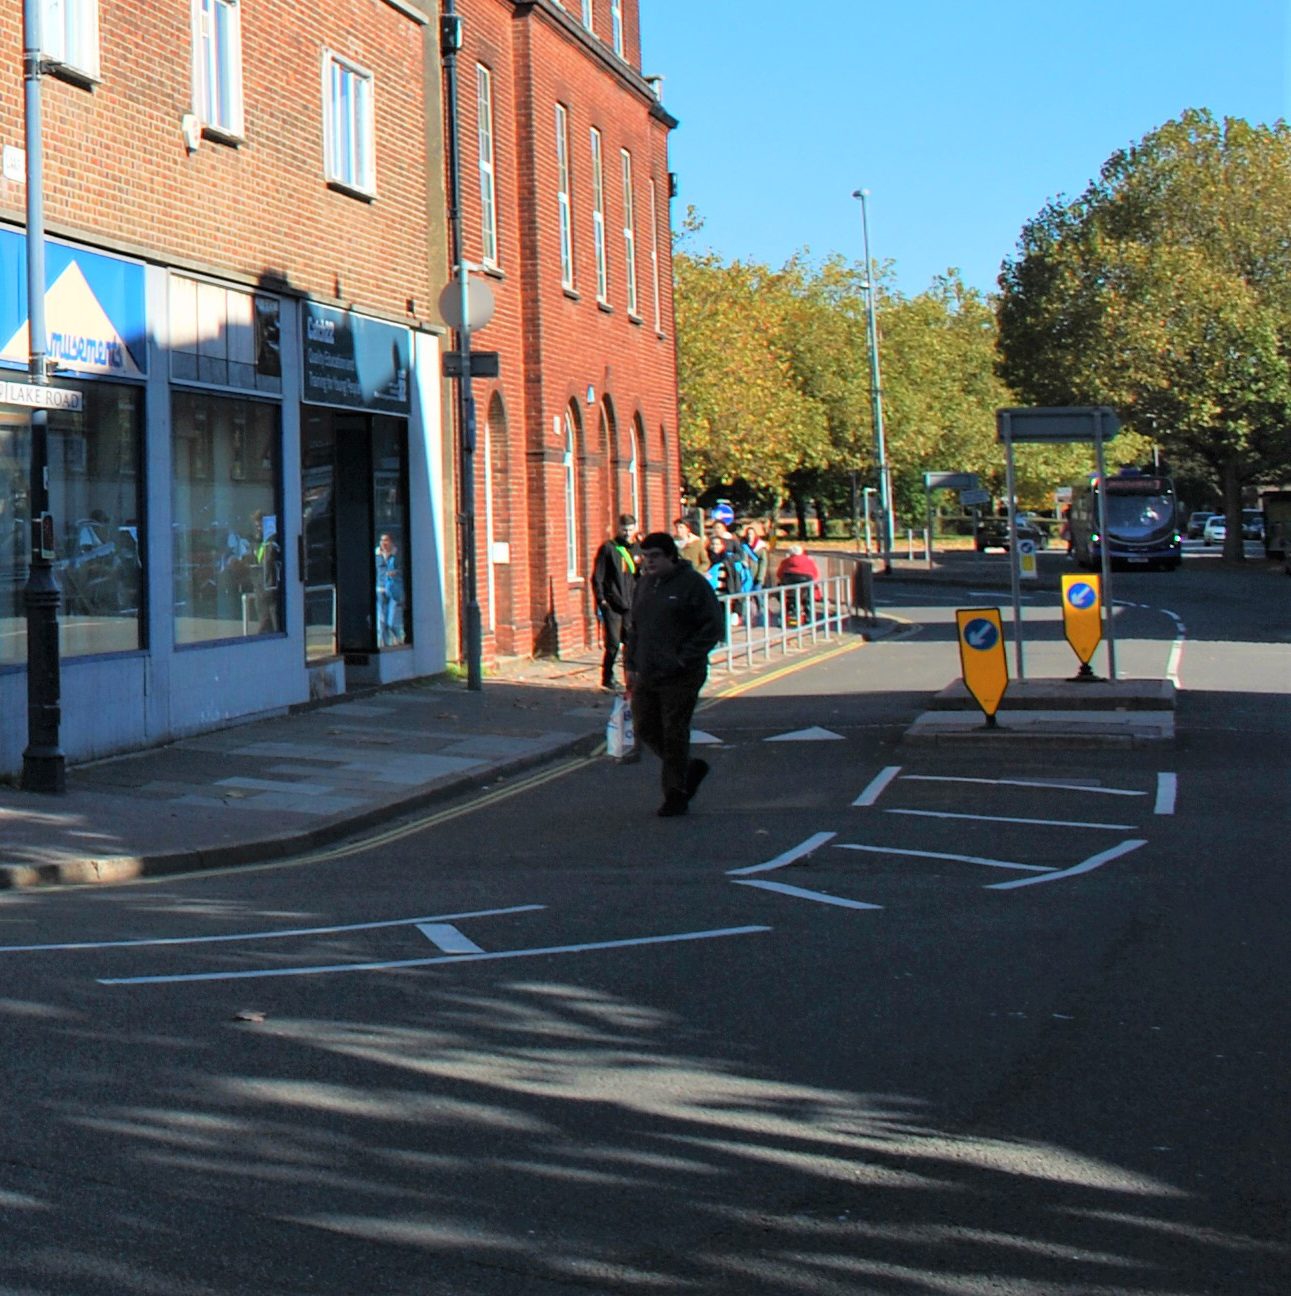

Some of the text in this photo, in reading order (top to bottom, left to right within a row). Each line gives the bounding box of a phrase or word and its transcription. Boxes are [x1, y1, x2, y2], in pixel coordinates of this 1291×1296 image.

[45, 332, 124, 368] musements
[10, 383, 79, 408] LAKE ROAD
